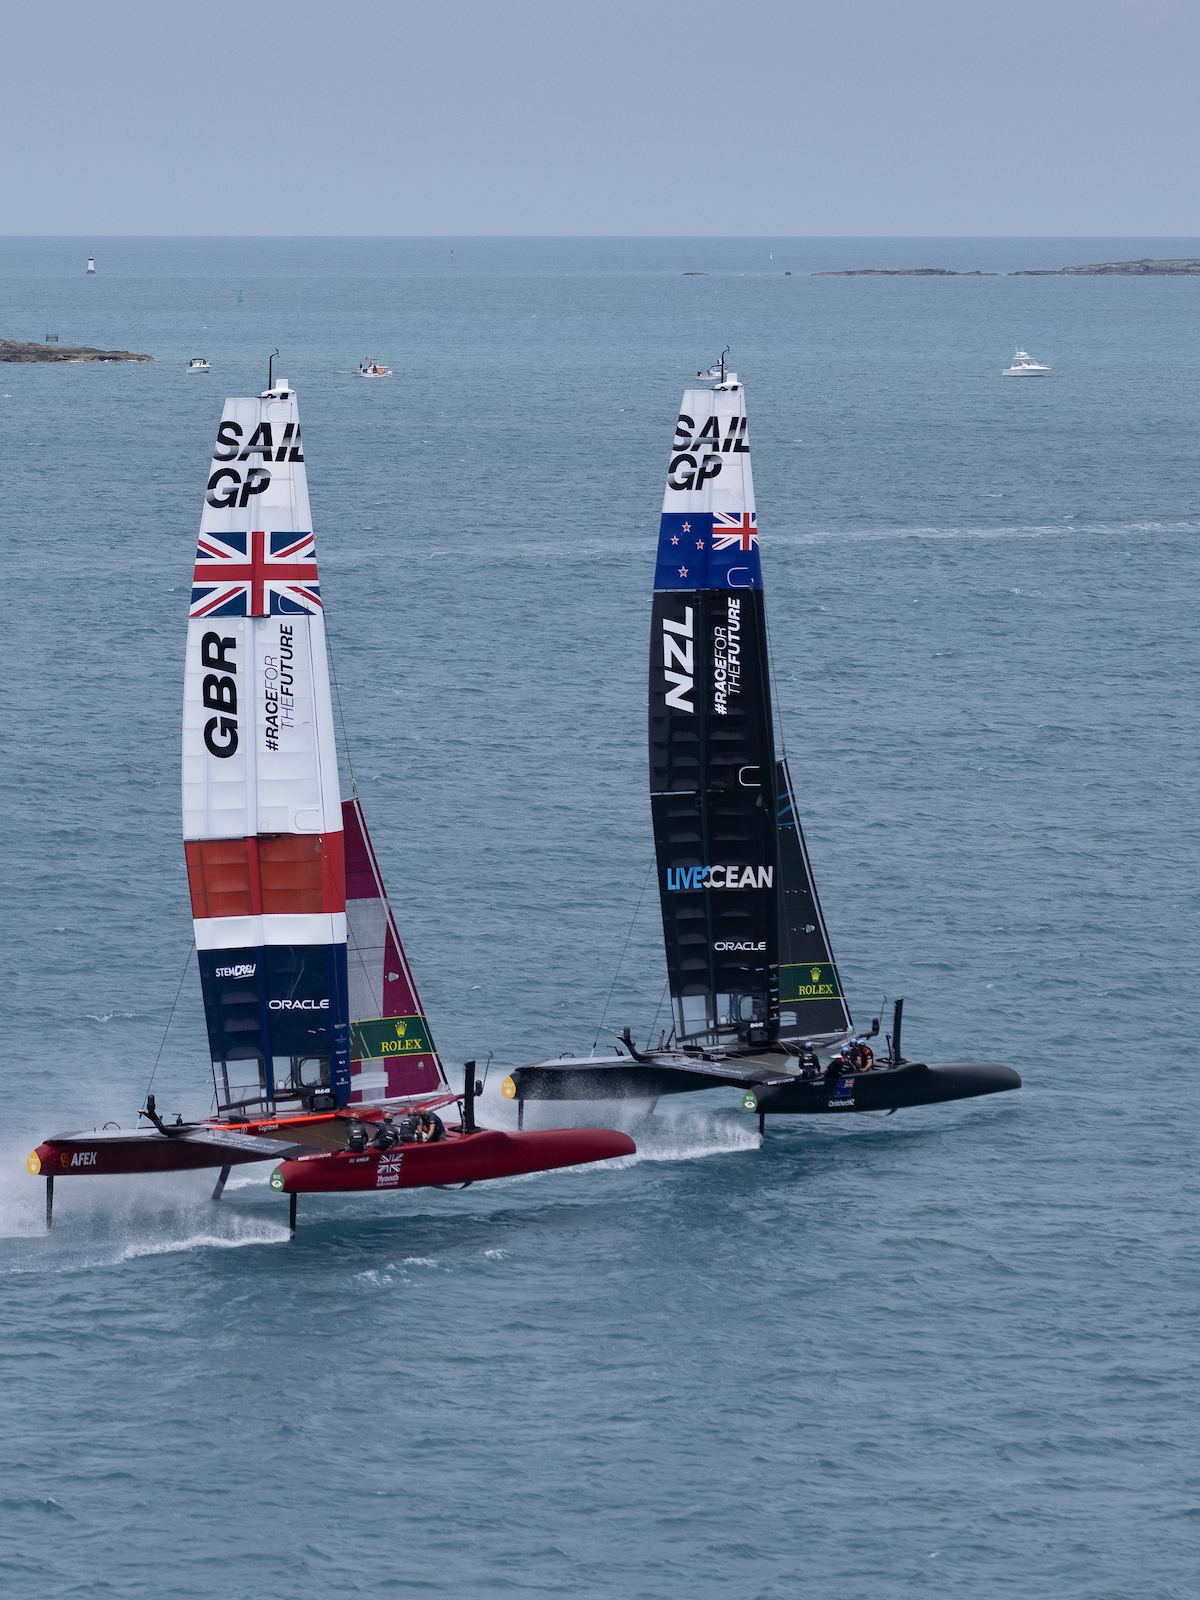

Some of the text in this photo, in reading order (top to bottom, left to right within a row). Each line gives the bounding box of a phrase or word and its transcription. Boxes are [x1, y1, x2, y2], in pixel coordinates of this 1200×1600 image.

[212, 421, 304, 463] SAIL
[671, 414, 750, 453] SAIL
[205, 467, 272, 509] GP
[667, 453, 724, 491] GP
[662, 605, 695, 714] NZL
[727, 597, 741, 696] THEFUTURE
[201, 631, 239, 759] GBR
[280, 623, 294, 730] THEFUTURE
[714, 941, 766, 951] ORACLE
[268, 999, 330, 1010] ORACLE
[798, 984, 833, 996] ROLEX
[381, 1038, 422, 1052] ROLEX
[71, 1151, 97, 1167] AFEX
